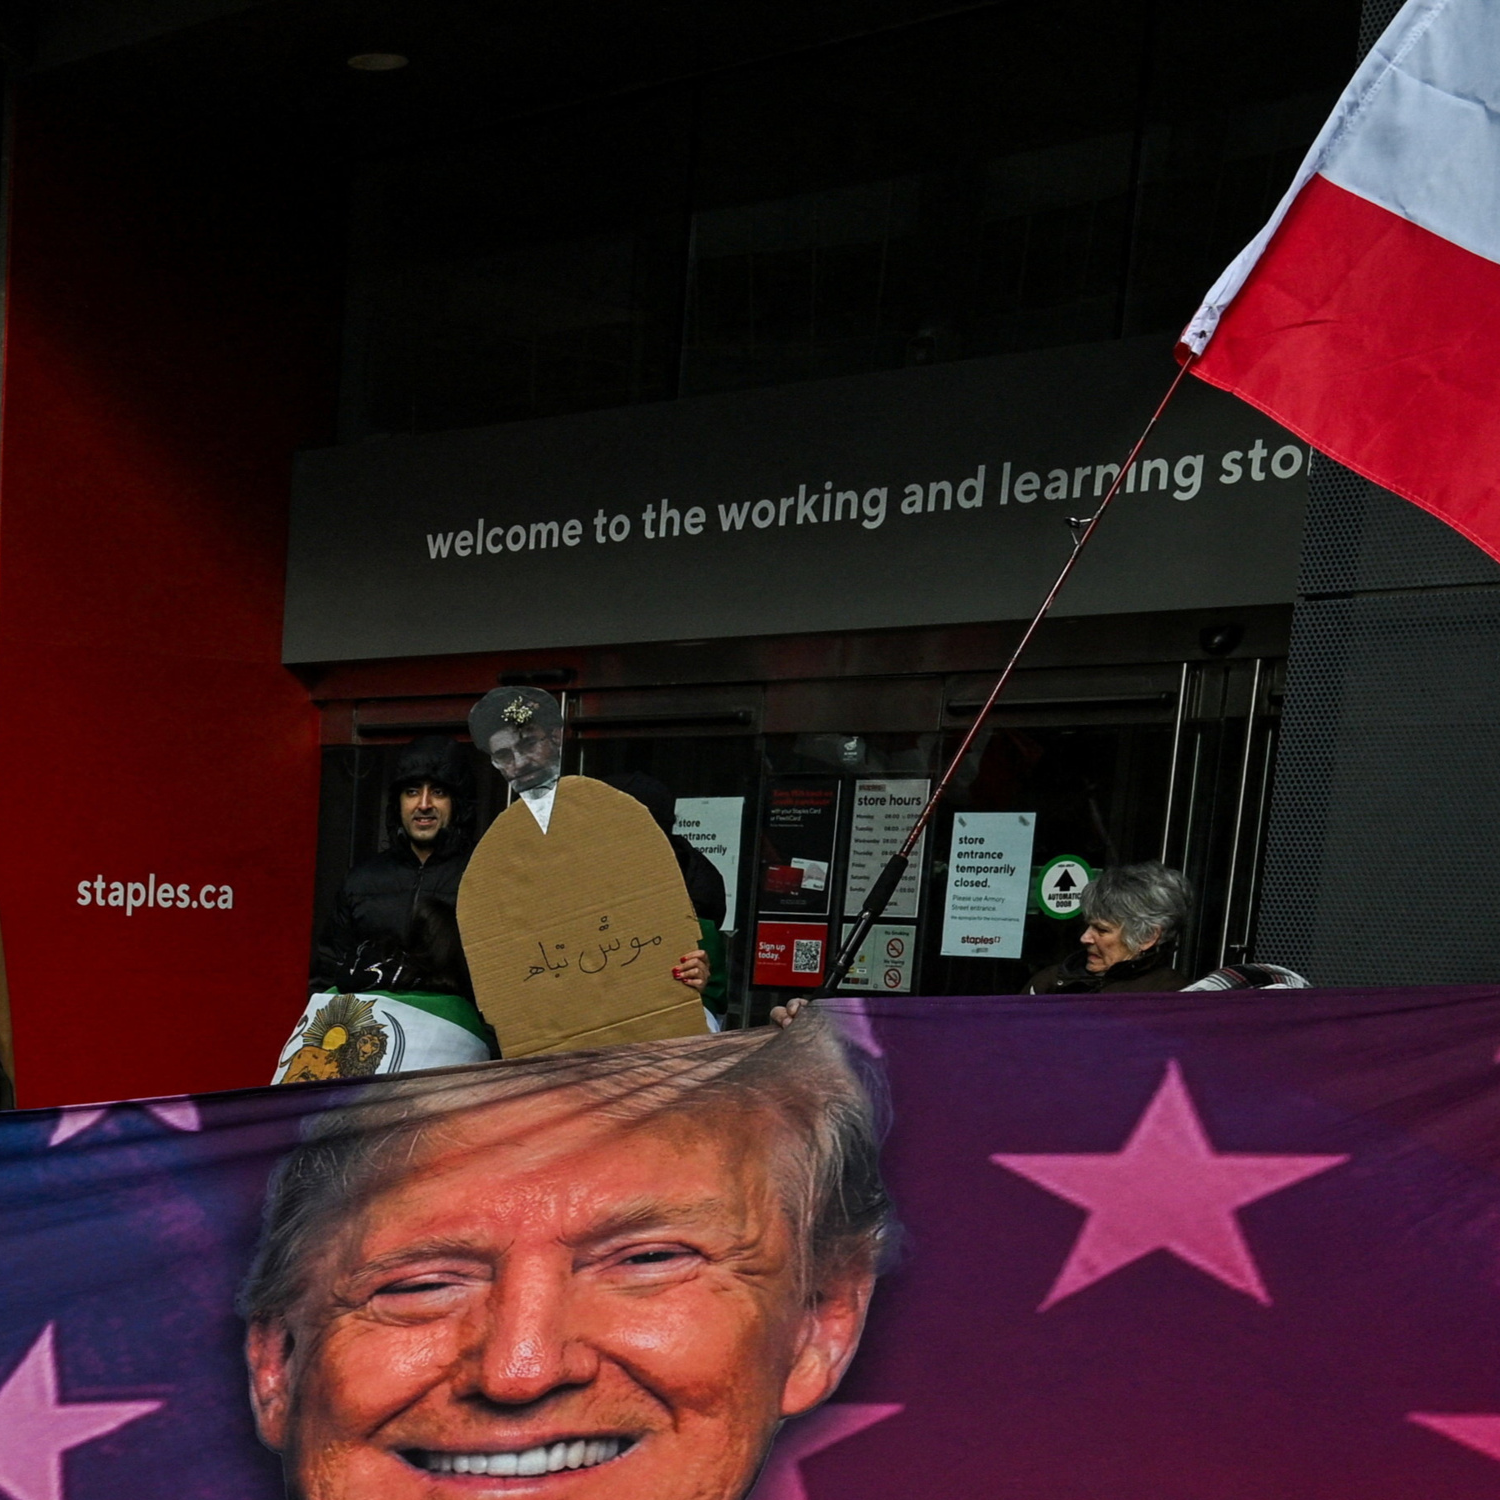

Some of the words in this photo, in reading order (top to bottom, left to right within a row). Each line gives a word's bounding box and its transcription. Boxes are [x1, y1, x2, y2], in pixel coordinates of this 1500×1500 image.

[426, 518, 583, 559] welcome
[593, 509, 631, 543] to
[642, 499, 706, 539] the
[717, 481, 888, 530] working
[900, 464, 986, 514] and
[999, 449, 1204, 505] learning
[1218, 439, 1314, 484] sto
[857, 795, 886, 806] store
[889, 794, 921, 806] hours
[678, 818, 701, 828] store
[958, 835, 985, 845] store
[957, 851, 1003, 860] entrance
[955, 864, 1016, 877] temporarily
[954, 877, 991, 888] closed.
[76, 873, 233, 916] staples.ca
[984, 895, 1006, 904] Armory
[1048, 892, 1081, 901] AUTOMATIC
[1056, 900, 1072, 908] DOOR
[961, 935, 994, 945] staples
[758, 942, 775, 952] Sign
[775, 944, 786, 953] up
[758, 951, 780, 961] today.
